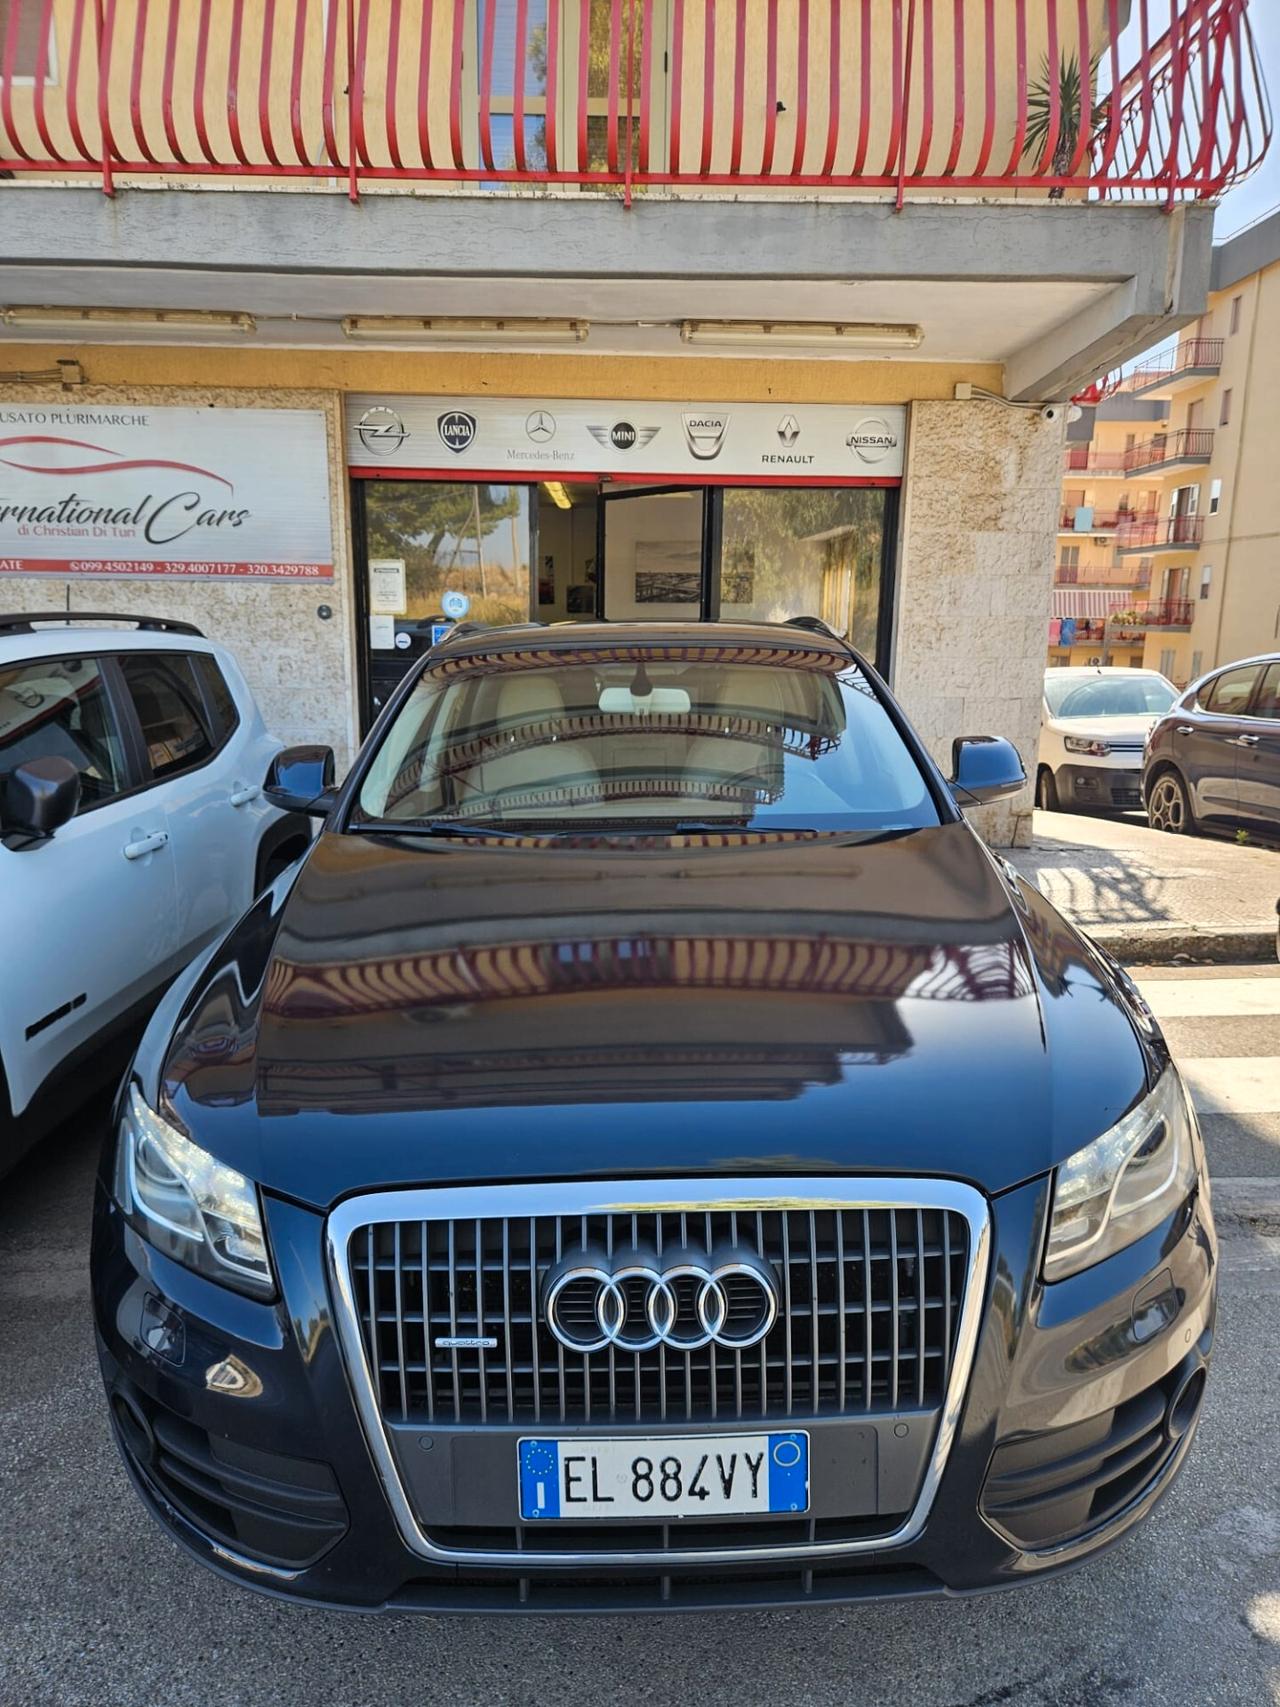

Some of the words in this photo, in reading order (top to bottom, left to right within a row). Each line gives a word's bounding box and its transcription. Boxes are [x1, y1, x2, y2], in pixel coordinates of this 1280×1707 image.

[0, 412, 47, 424] USATO
[51, 413, 150, 426] PLURIMARCHE
[689, 419, 723, 429] DACIA
[444, 424, 471, 437] LANCIA
[612, 431, 635, 441] MINI
[850, 435, 893, 445] NISSAN
[506, 449, 575, 461] Mercedes-Benz
[761, 454, 815, 465] RENAULT
[144, 491, 251, 545] Cars
[17, 524, 30, 536] di
[33, 525, 89, 537] Christian
[93, 526, 107, 537] Di
[81, 561, 154, 572] 099.4502149
[164, 562, 236, 574] 329.4007177
[247, 564, 320, 576] 320.3429788
[442, 1339, 490, 1347] quattro
[564, 1456, 615, 1503] EL
[631, 1452, 764, 1502] 884VY
